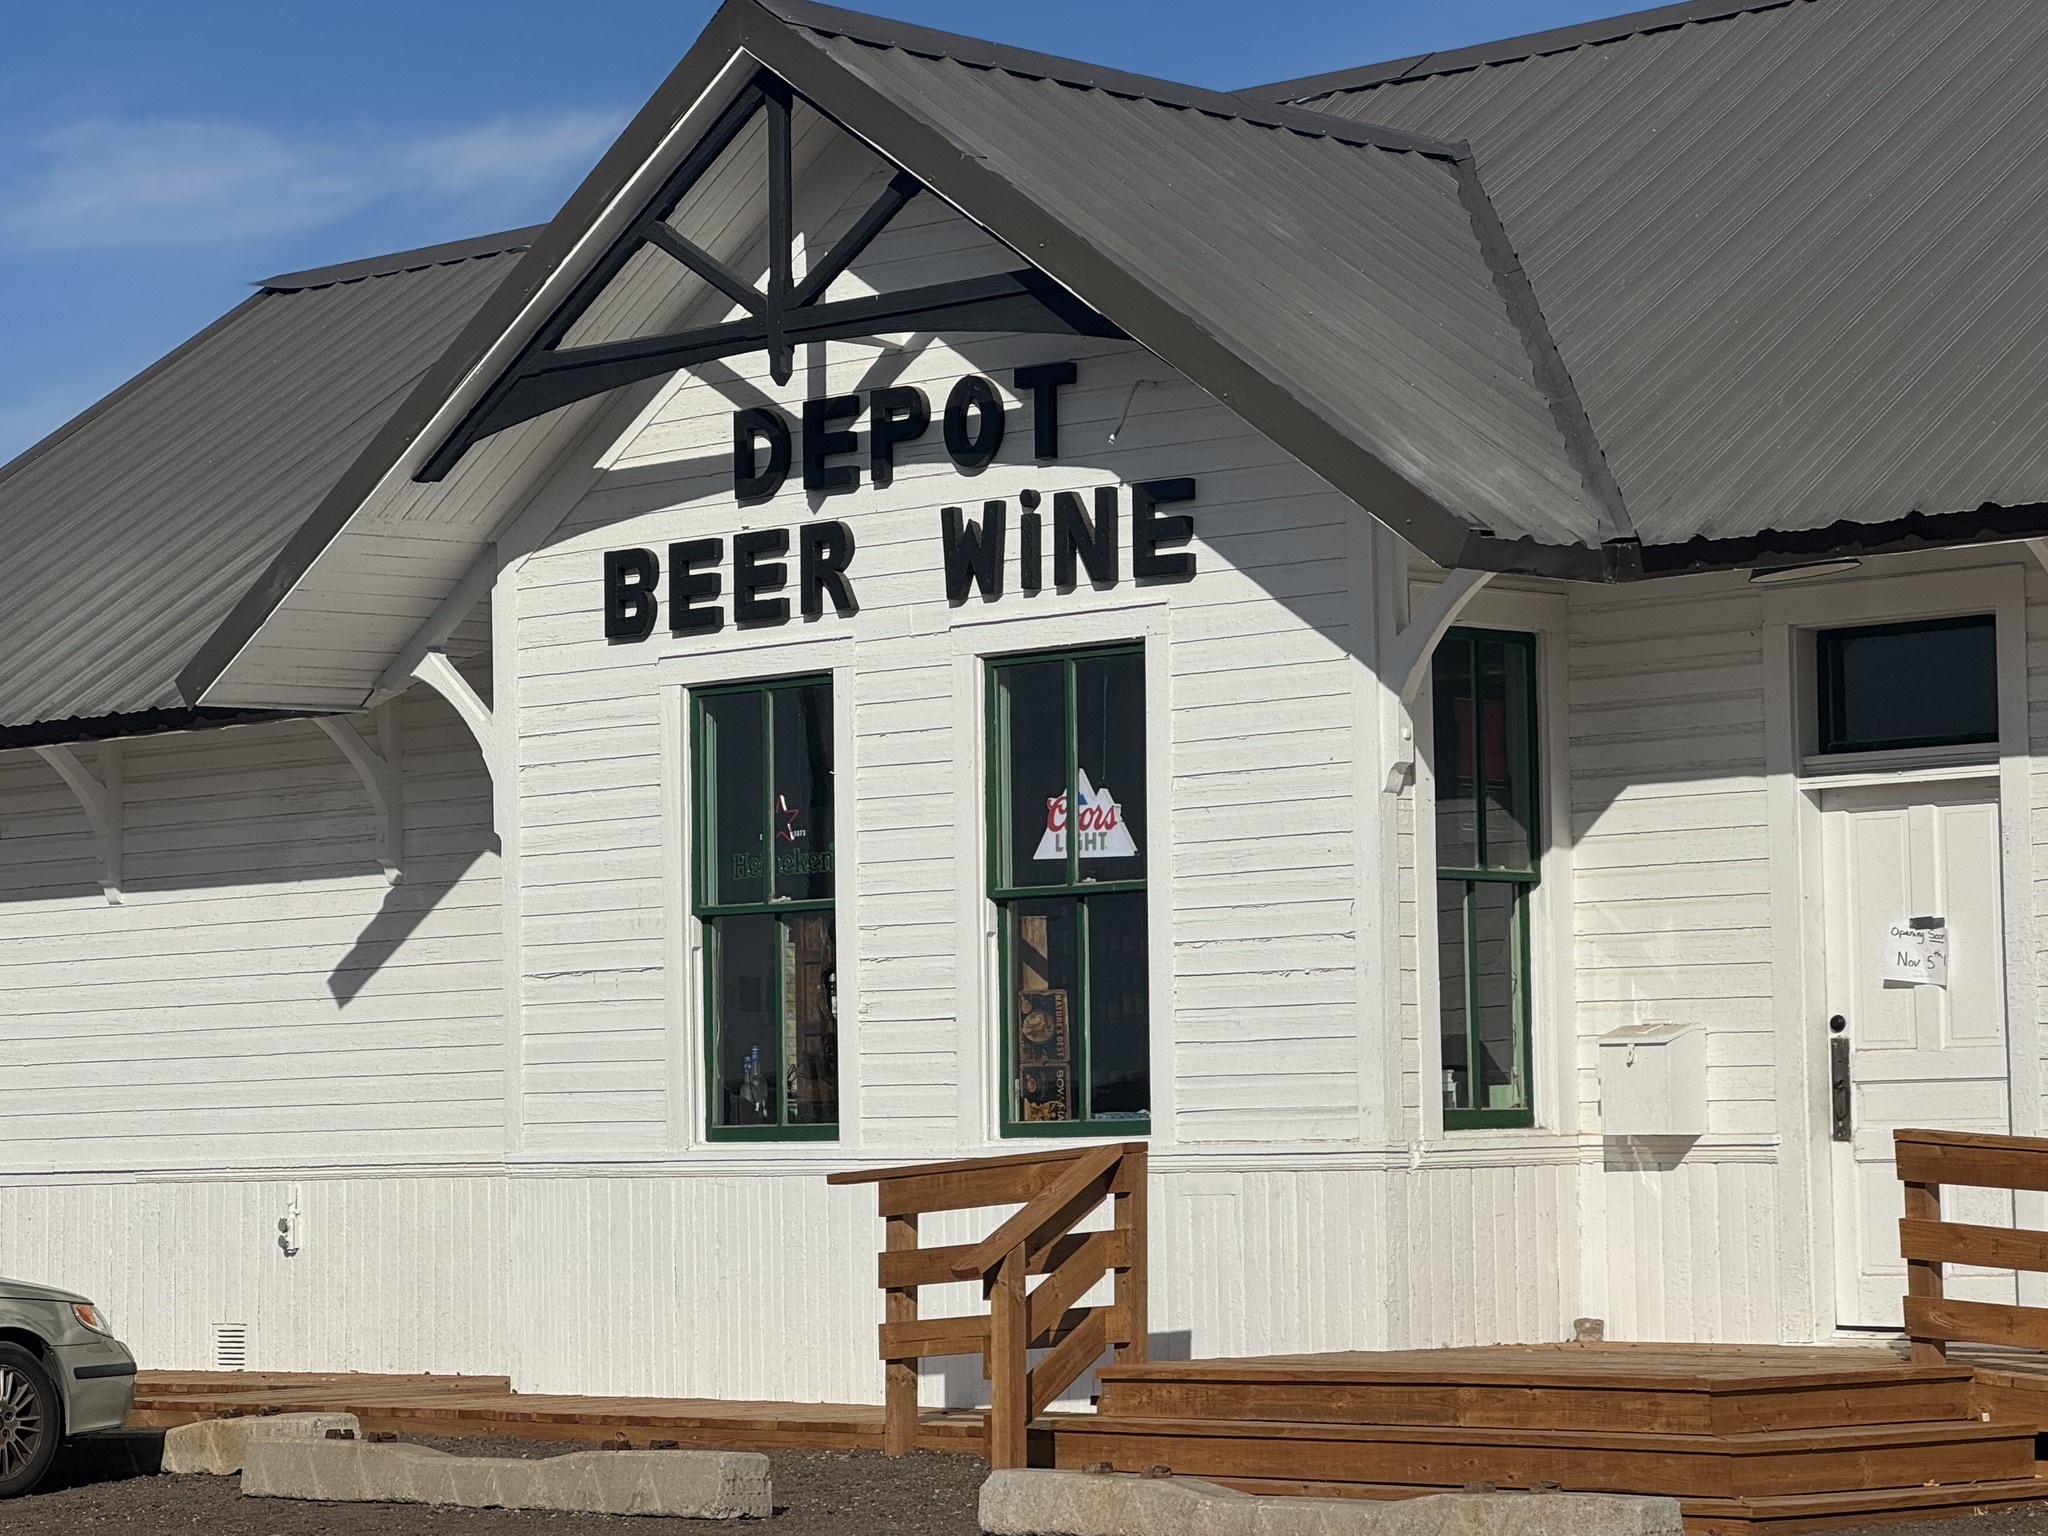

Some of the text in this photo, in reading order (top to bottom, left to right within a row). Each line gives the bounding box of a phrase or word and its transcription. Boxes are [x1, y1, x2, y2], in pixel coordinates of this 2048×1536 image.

[734, 362, 1077, 501] DEPOT
[603, 519, 858, 642] BEER
[1047, 796, 1117, 832] Cors
[1056, 832, 1107, 852] LHT
[733, 848, 834, 880] Heeken
[1891, 927, 1924, 944] Opening
[1897, 951, 1921, 967] Nov
[1056, 1036, 1066, 1057] BEST
